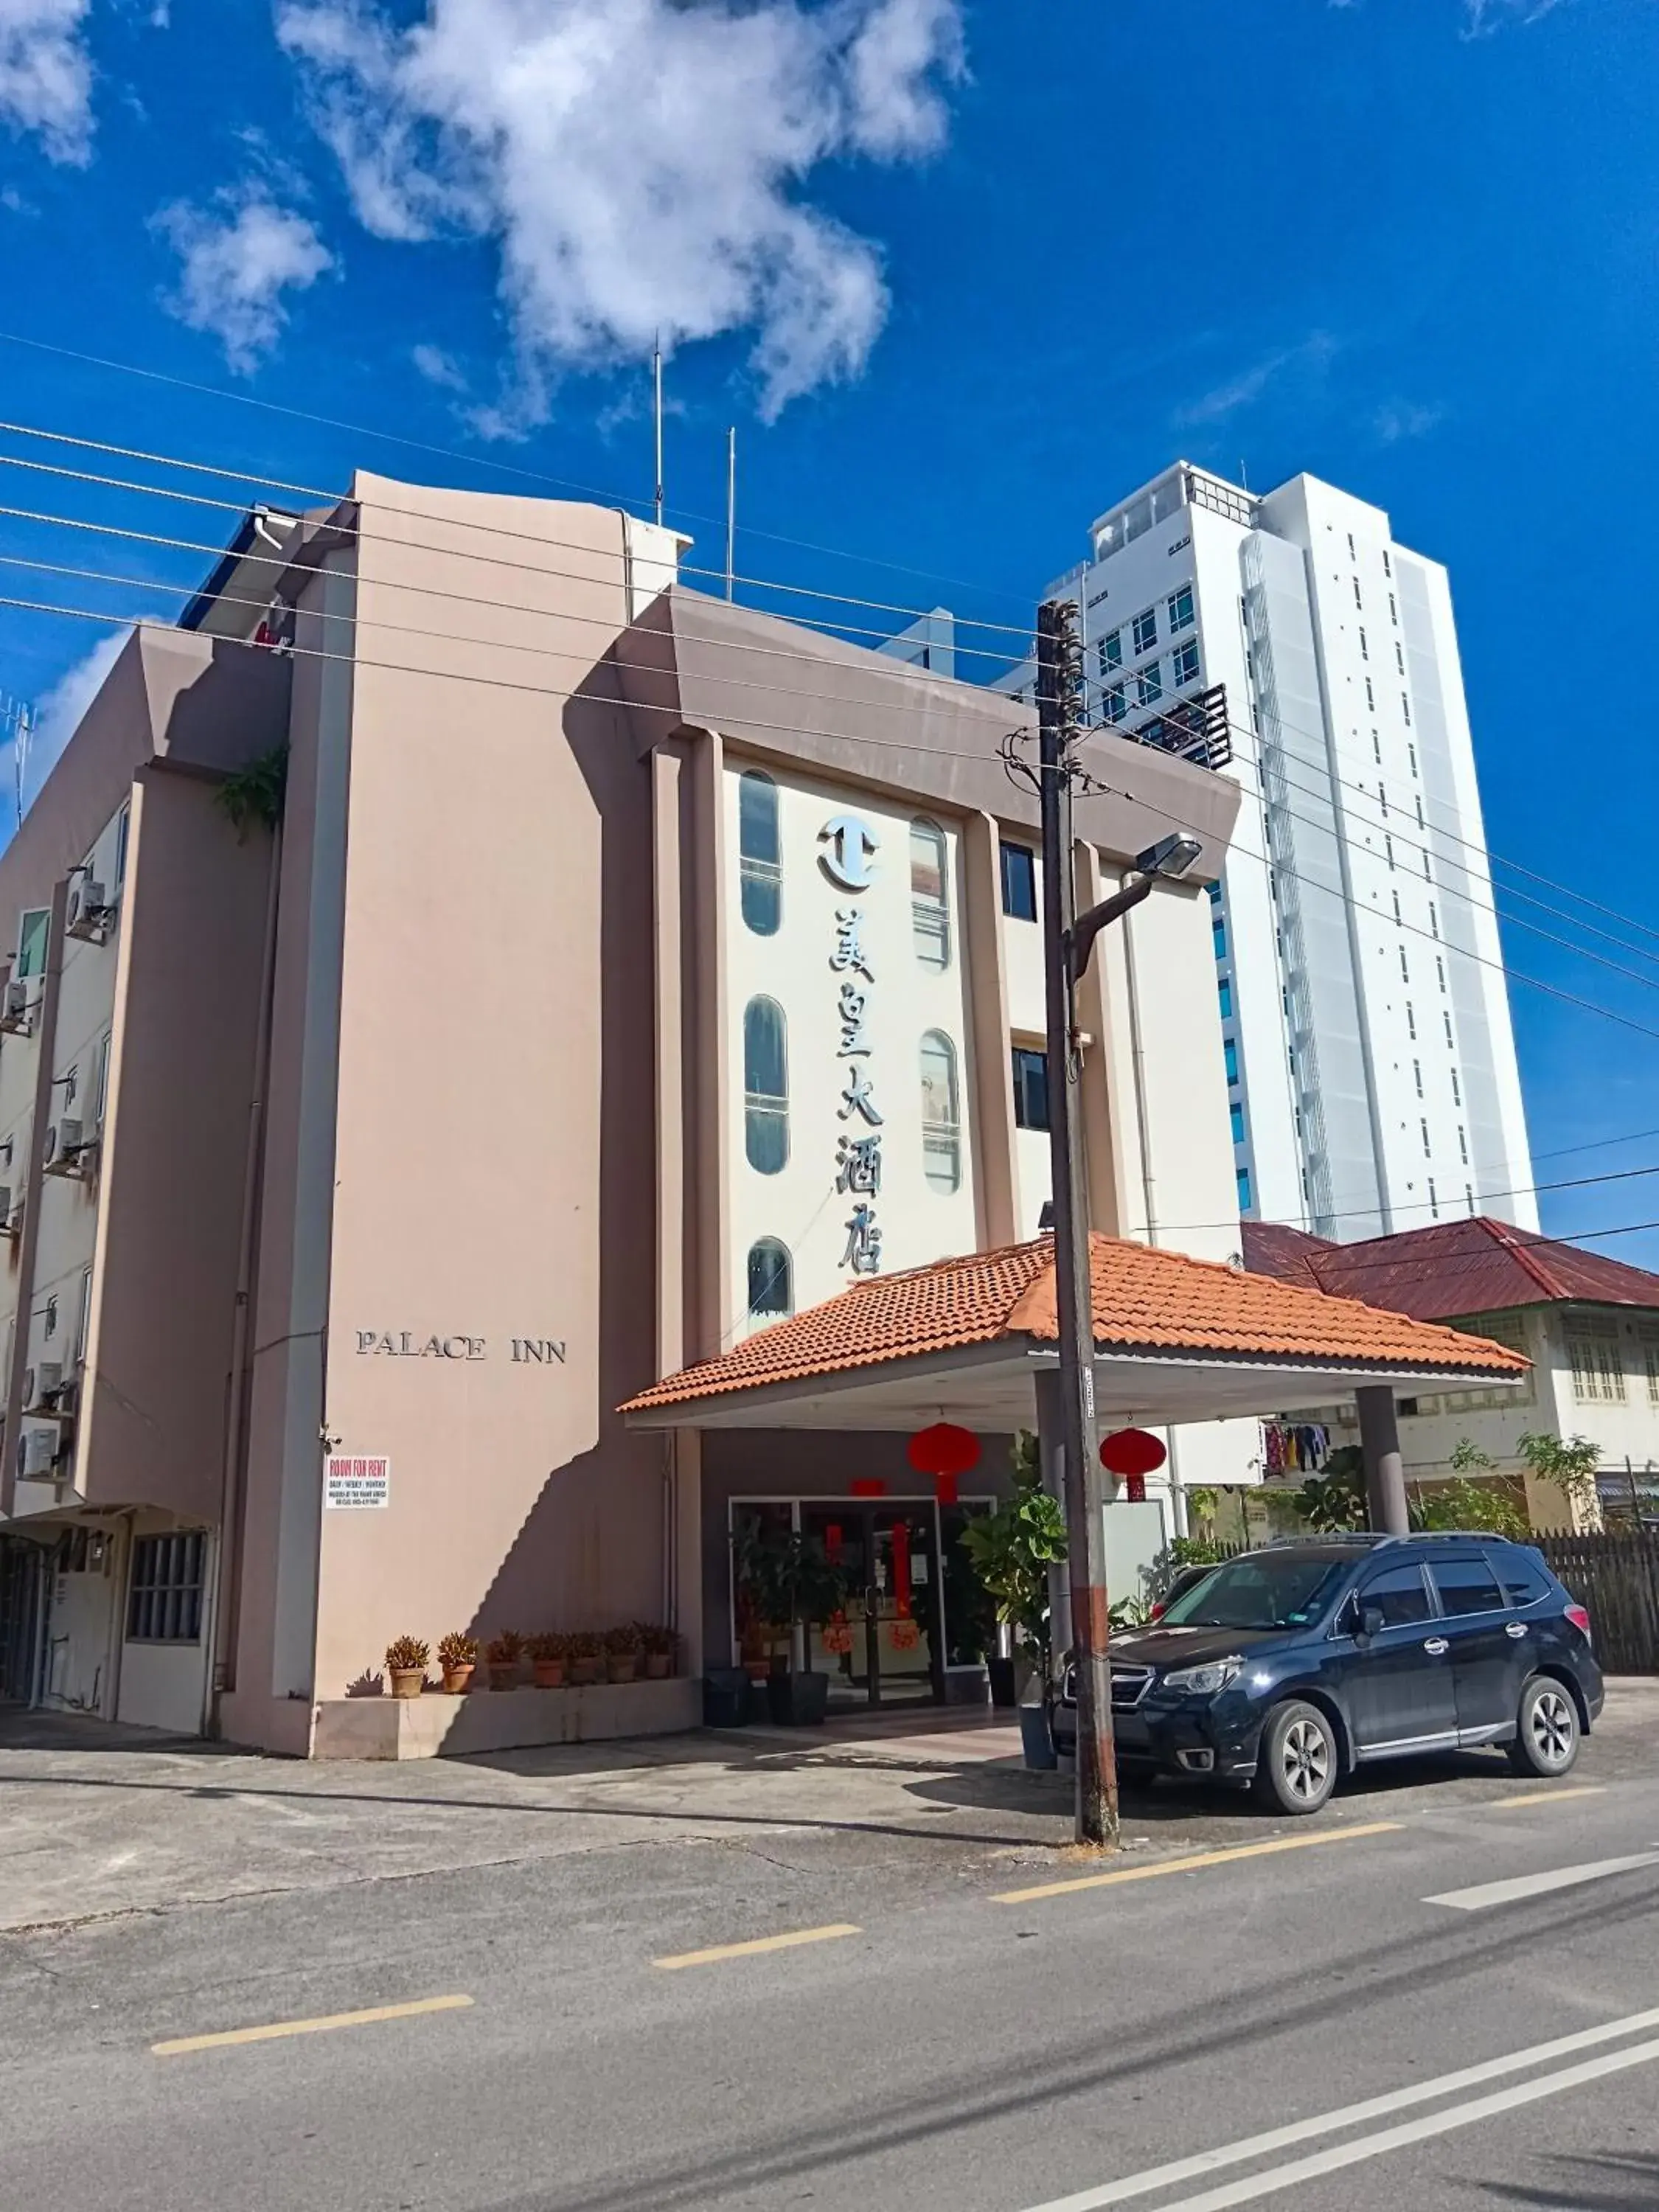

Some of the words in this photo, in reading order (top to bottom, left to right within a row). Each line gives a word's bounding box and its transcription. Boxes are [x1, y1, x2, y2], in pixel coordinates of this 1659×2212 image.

[355, 1330, 486, 1360] PALACE
[510, 1338, 566, 1364] INN
[330, 1459, 352, 1477] ROOM
[353, 1459, 366, 1477] FOR
[369, 1459, 386, 1477] RENT
